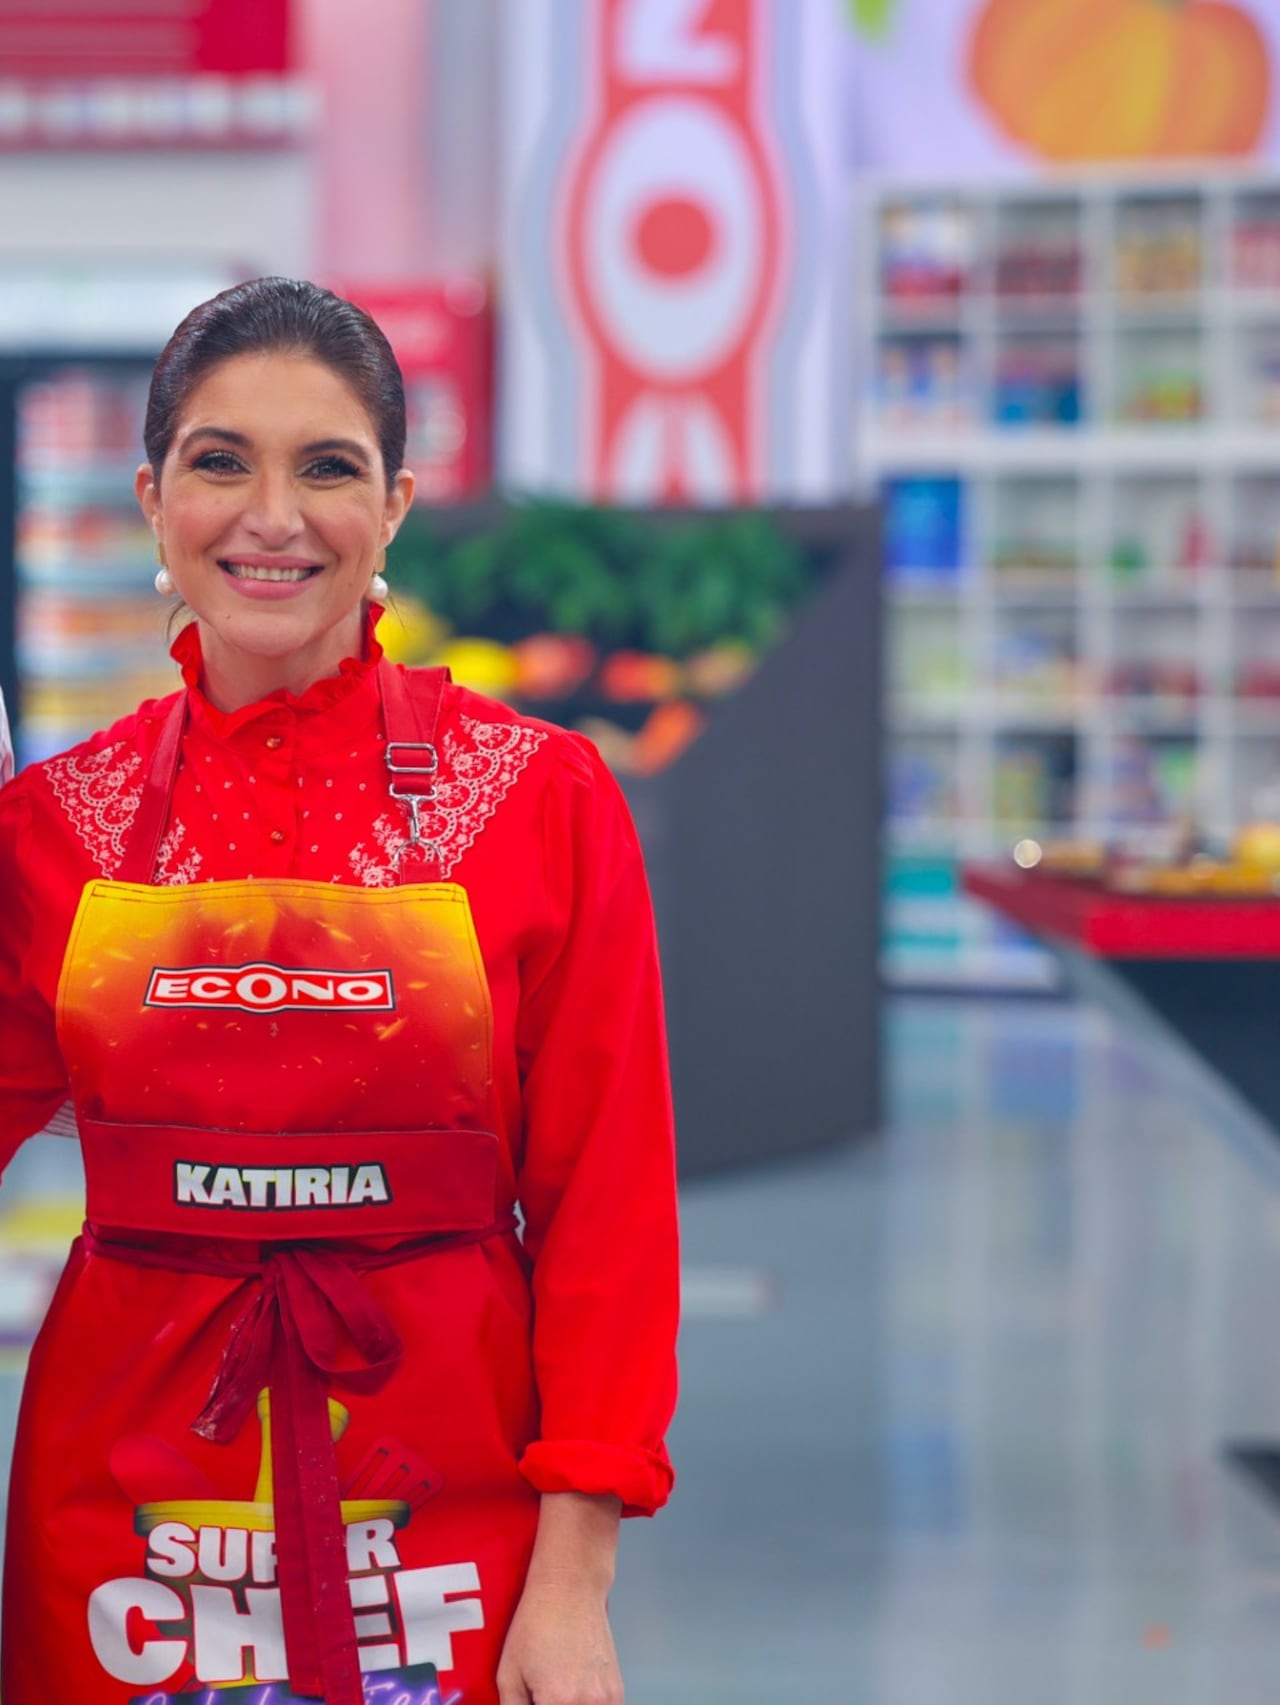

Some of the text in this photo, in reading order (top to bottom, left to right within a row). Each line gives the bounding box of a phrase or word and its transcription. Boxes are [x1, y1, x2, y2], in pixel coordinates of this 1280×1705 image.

[154, 972, 384, 1004] ECONO
[176, 1163, 389, 1208] KATIRIA
[146, 1518, 402, 1583] SUPR
